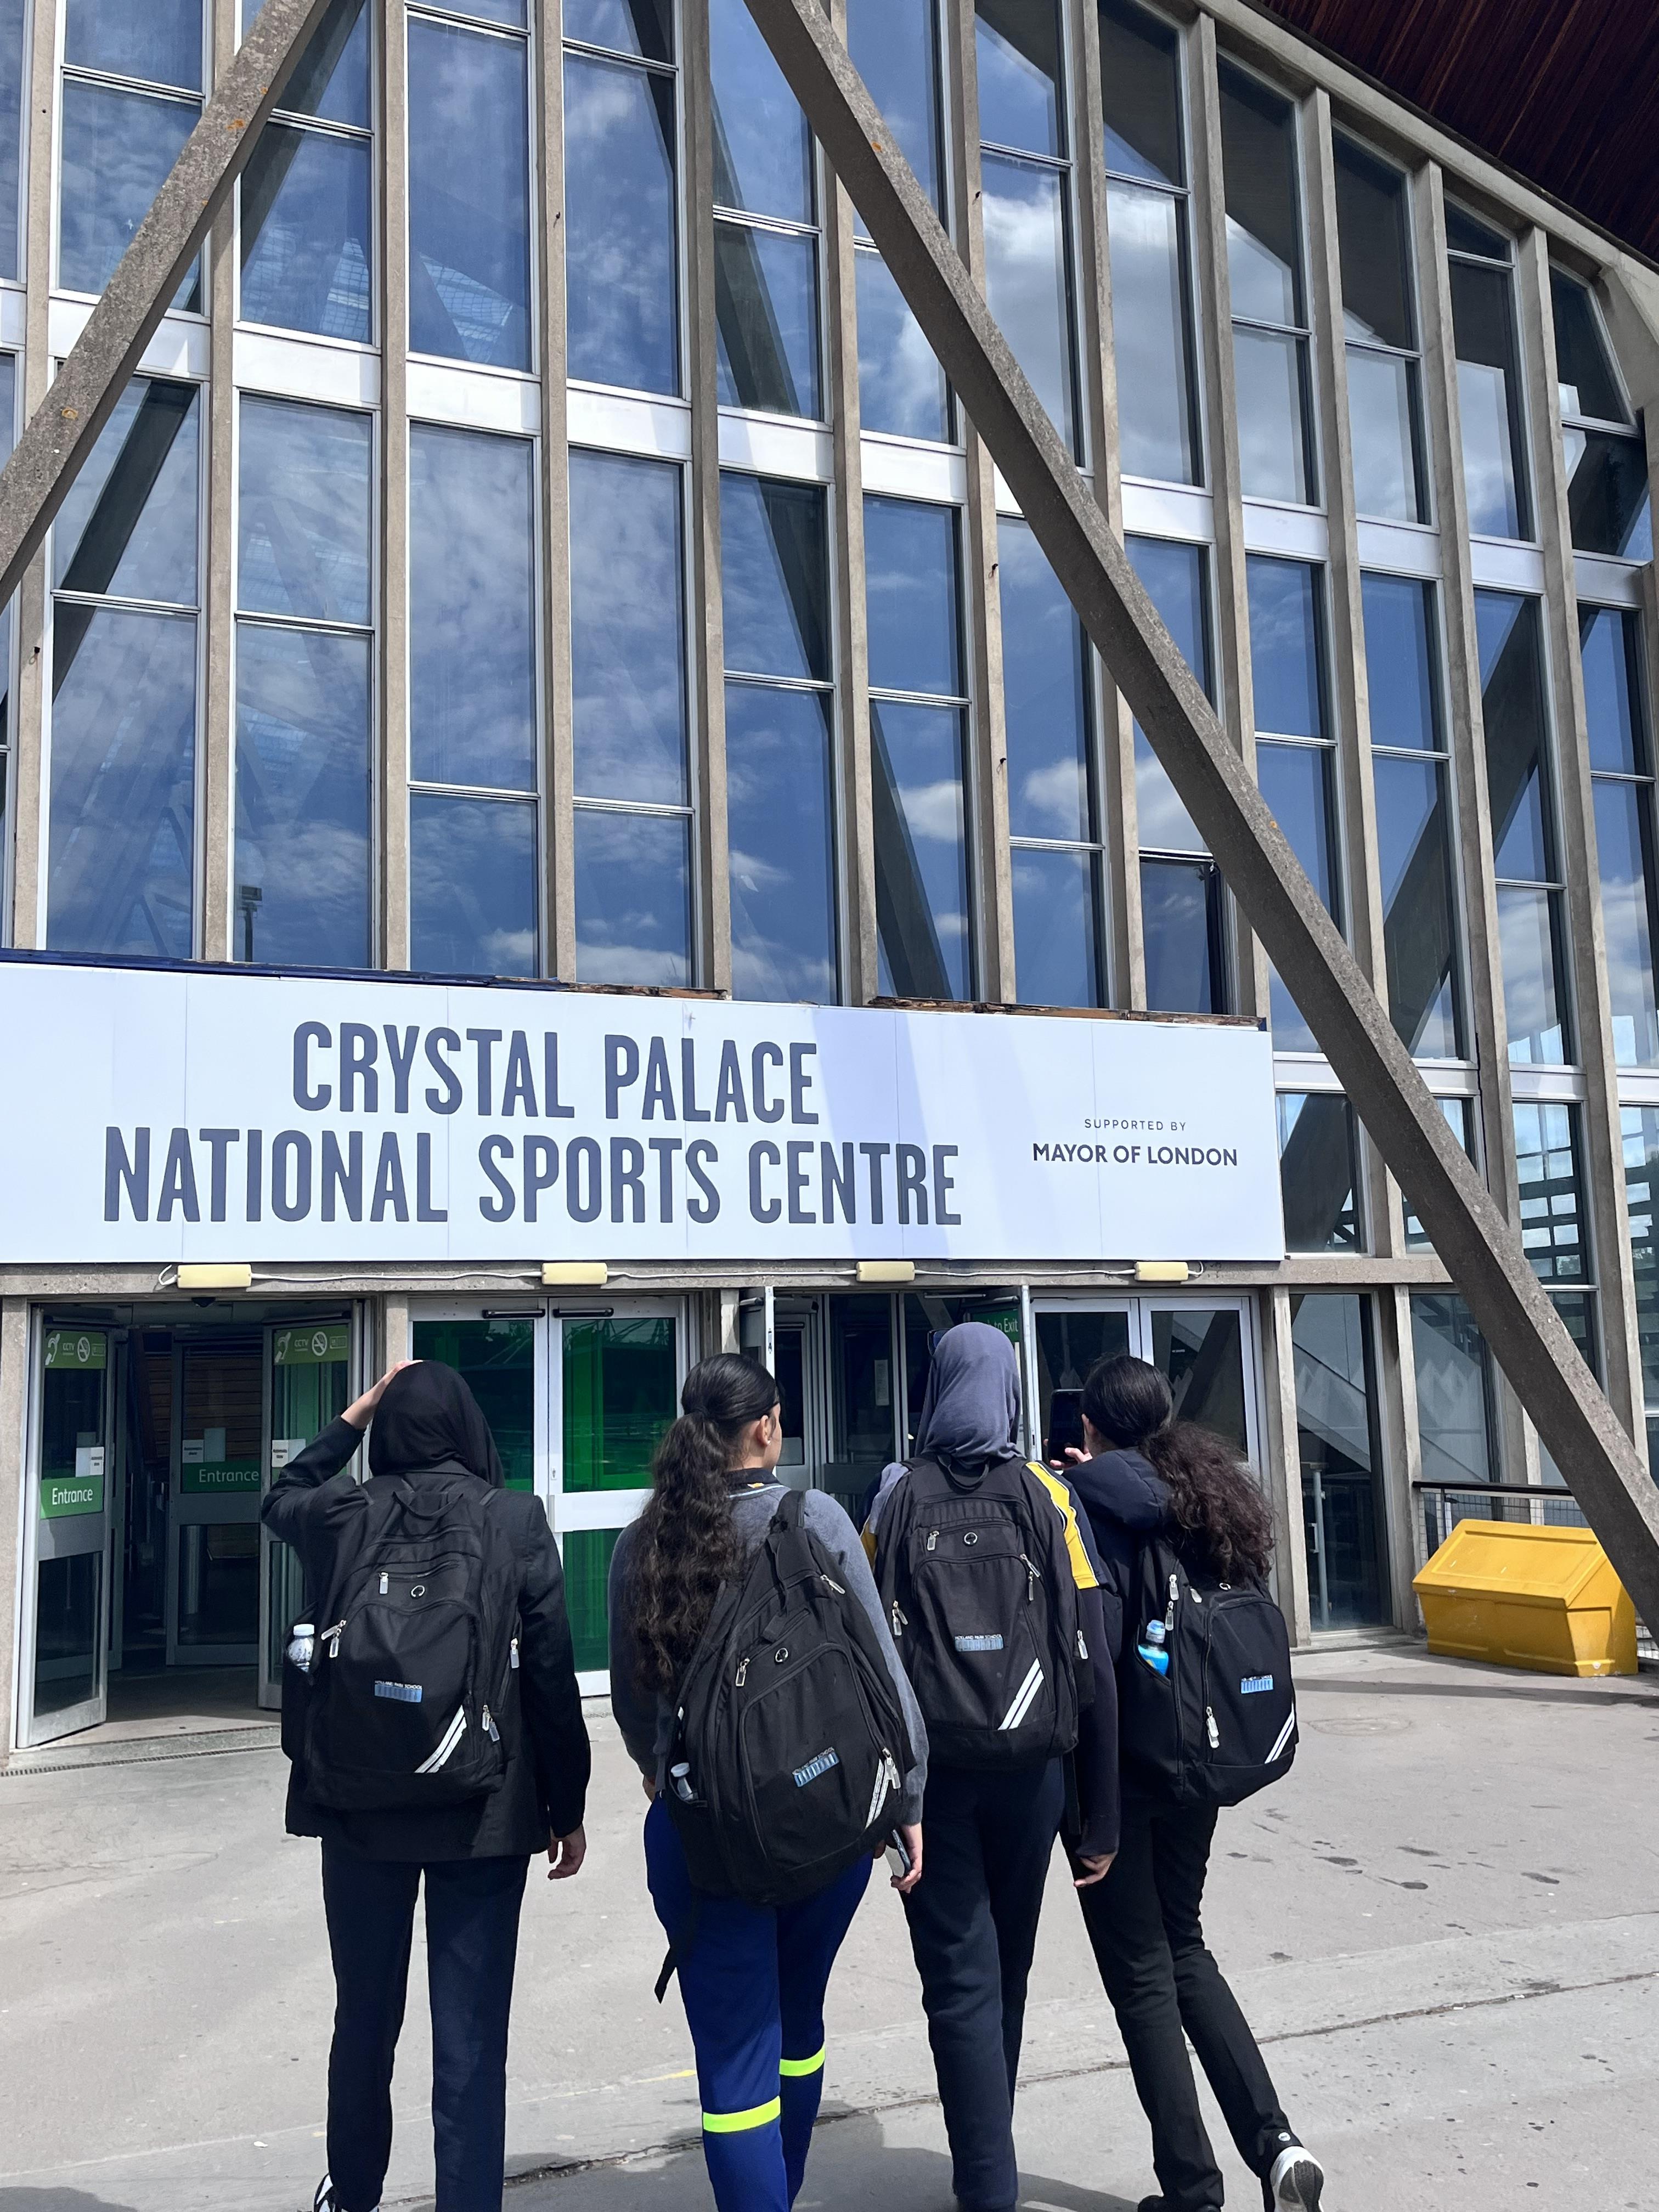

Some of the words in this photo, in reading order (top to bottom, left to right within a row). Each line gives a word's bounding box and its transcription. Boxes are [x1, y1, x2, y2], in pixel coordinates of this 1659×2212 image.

[293, 1021, 575, 1119] CRYSTAL
[605, 1034, 819, 1125] PALACE
[1084, 1119, 1164, 1131] SUPPORTED
[1170, 1122, 1186, 1131] BY
[1032, 1143, 1108, 1163] MAYOR
[1113, 1145, 1141, 1164] OF
[1148, 1146, 1238, 1166] LONDON
[104, 1126, 448, 1222] NATIONAL
[478, 1134, 720, 1224] SPORTS
[748, 1140, 962, 1225] CENTRE
[1003, 1318, 1019, 1333] Exit
[63, 1342, 75, 1351] CCTV
[294, 1339, 309, 1347] CCTV
[199, 1469, 259, 1483] Entrance
[52, 1487, 93, 1505] Entrance
